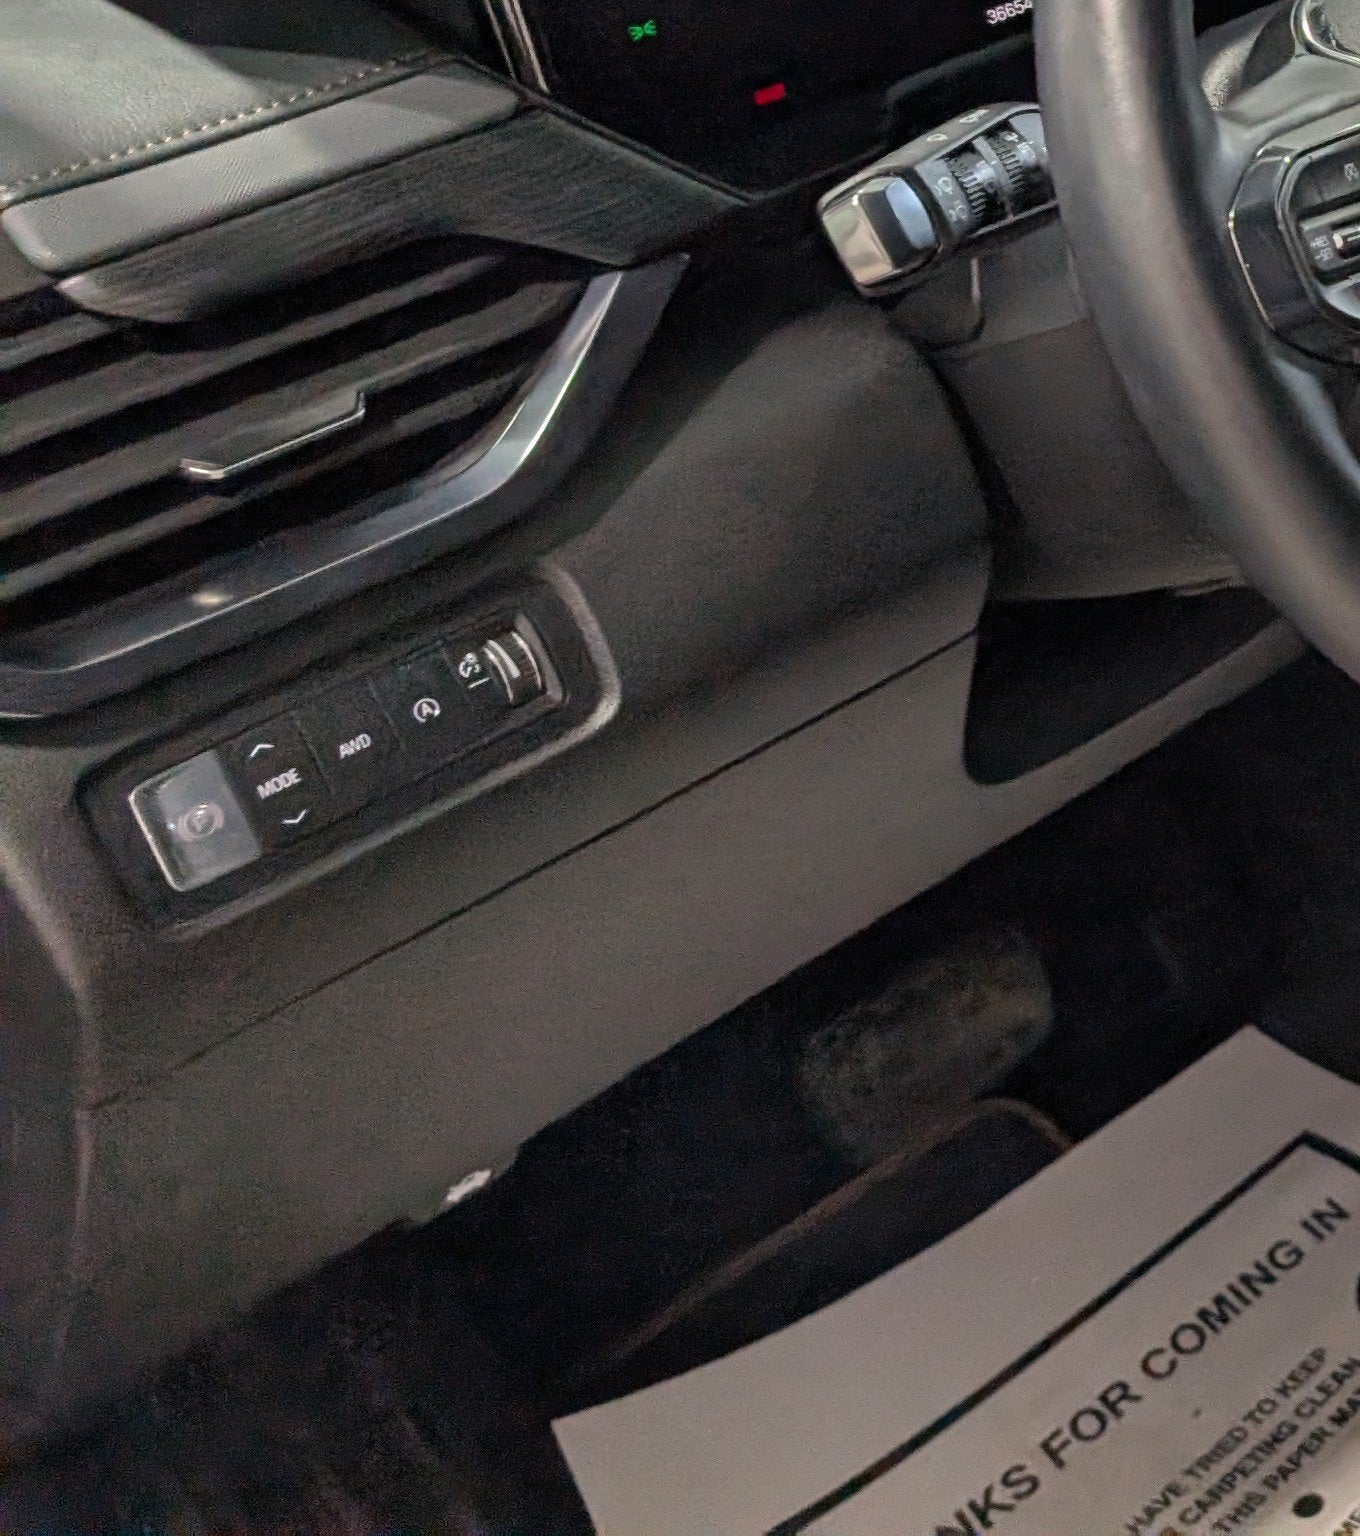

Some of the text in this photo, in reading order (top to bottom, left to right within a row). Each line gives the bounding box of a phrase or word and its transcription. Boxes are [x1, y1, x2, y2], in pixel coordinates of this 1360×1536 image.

[256, 767, 303, 802] MODE
[338, 732, 372, 761] AWD
[1039, 1380, 1143, 1469] FOR
[1140, 1238, 1306, 1381] COMING
[1301, 1196, 1352, 1242] IN
[1183, 1425, 1249, 1480] TRIED
[1242, 1396, 1279, 1426] TO
[1274, 1346, 1328, 1399] KEEP
[1178, 1419, 1299, 1526] CARPETING
[1261, 1425, 1334, 1492] PAPER
